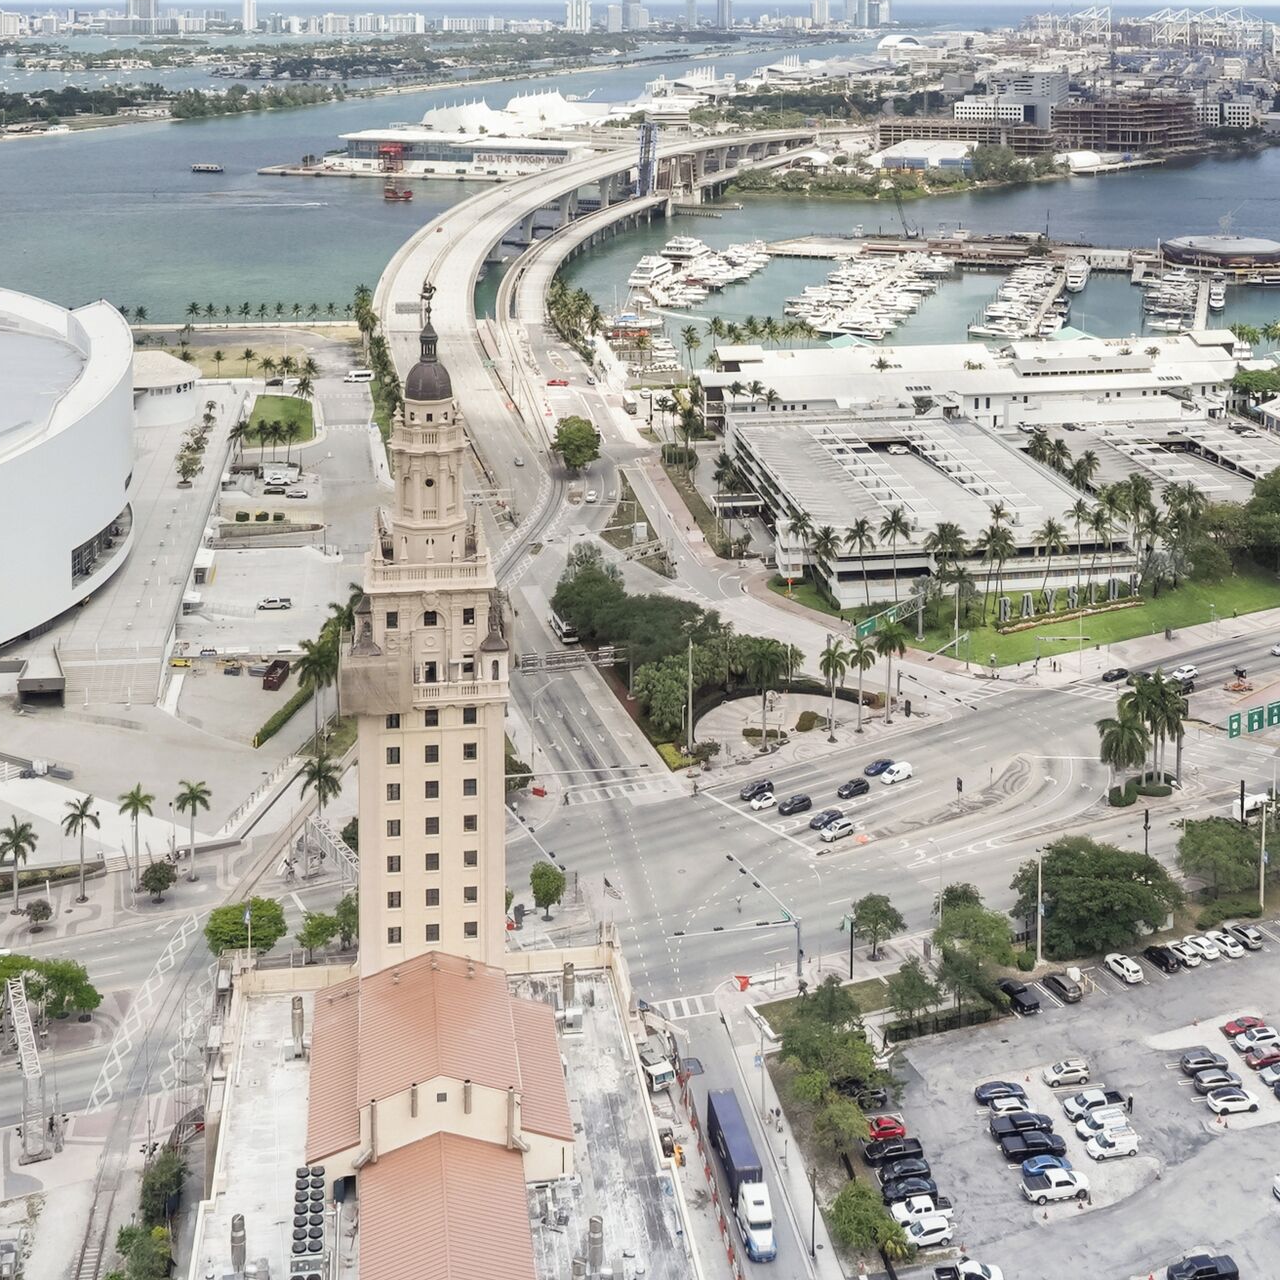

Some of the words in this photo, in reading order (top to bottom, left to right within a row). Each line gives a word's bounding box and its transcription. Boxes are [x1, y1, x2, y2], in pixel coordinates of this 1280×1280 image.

[477, 154, 495, 163] SAIL
[496, 155, 512, 164] THE
[514, 155, 545, 165] VIRGIN
[546, 156, 565, 165] WAY
